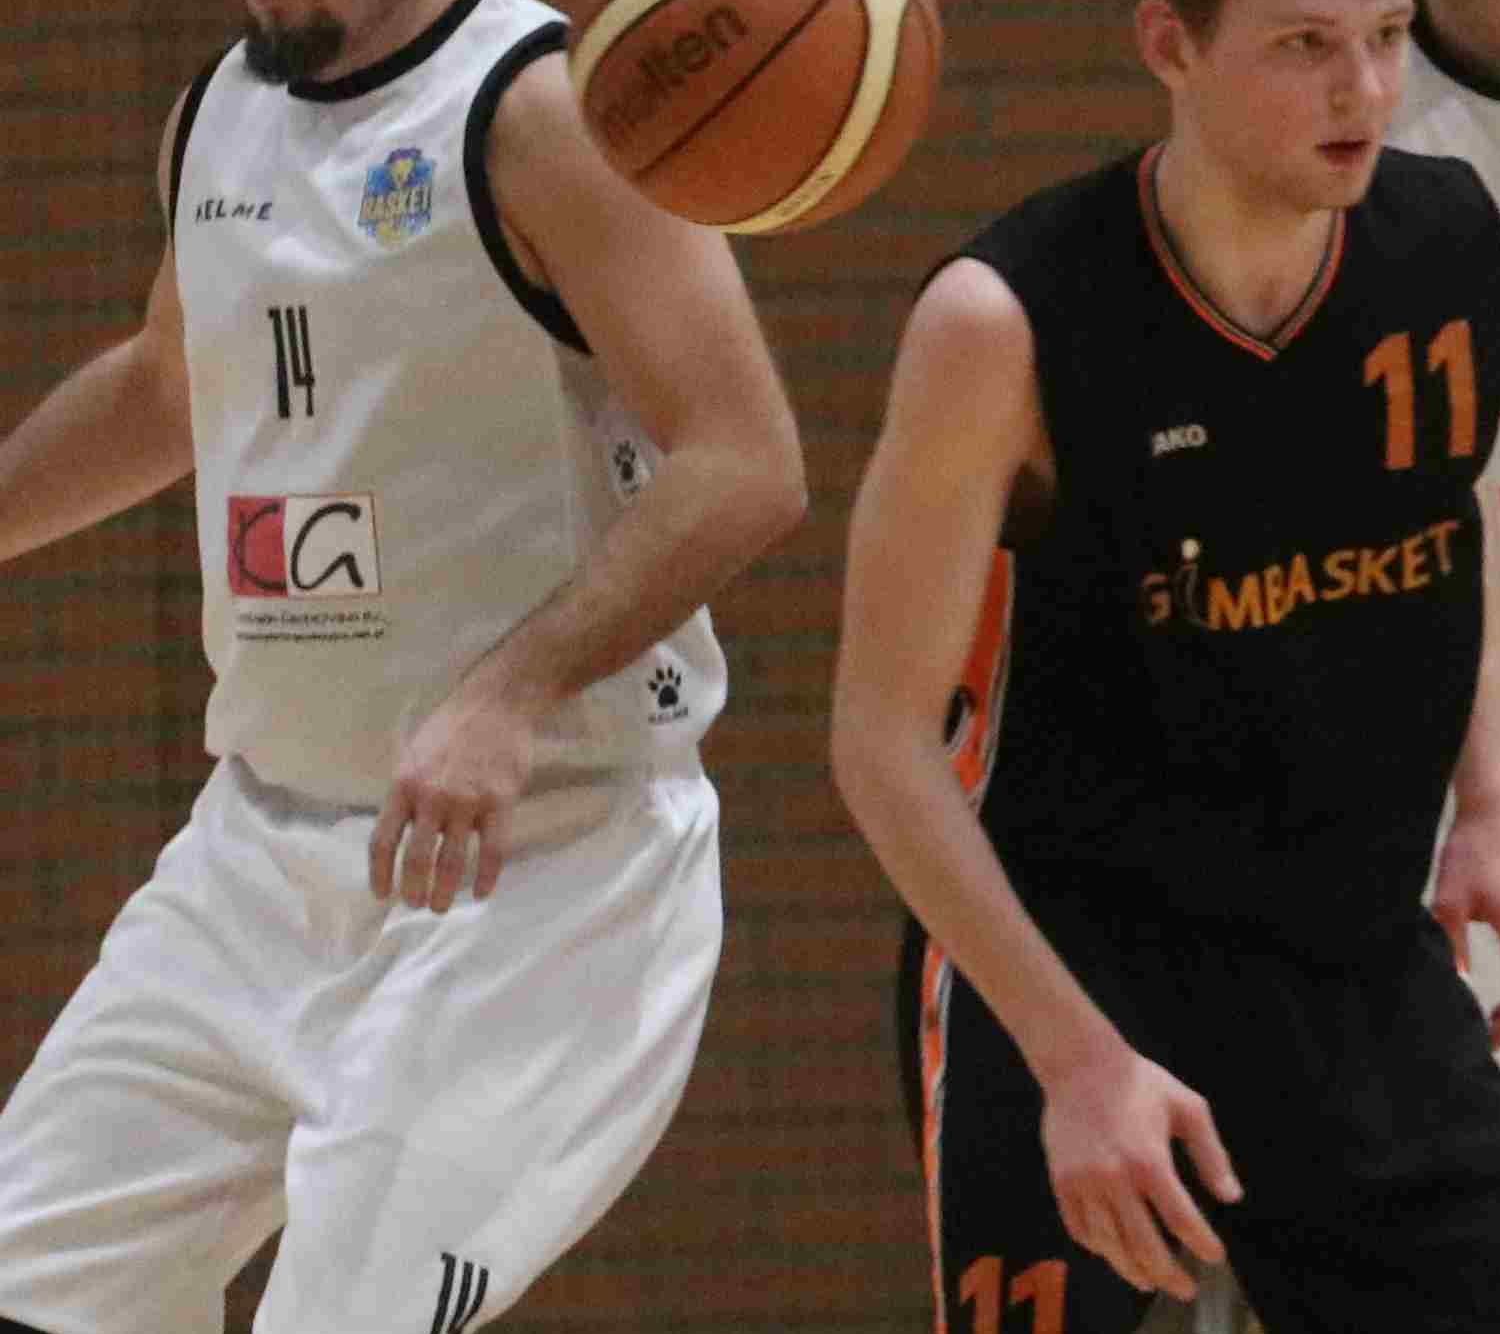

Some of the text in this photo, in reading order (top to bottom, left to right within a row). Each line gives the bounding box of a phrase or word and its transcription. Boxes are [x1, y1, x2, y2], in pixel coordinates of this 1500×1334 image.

[267, 304, 315, 418] 14
[1364, 320, 1476, 470] 11
[1152, 424, 1207, 456] AKO
